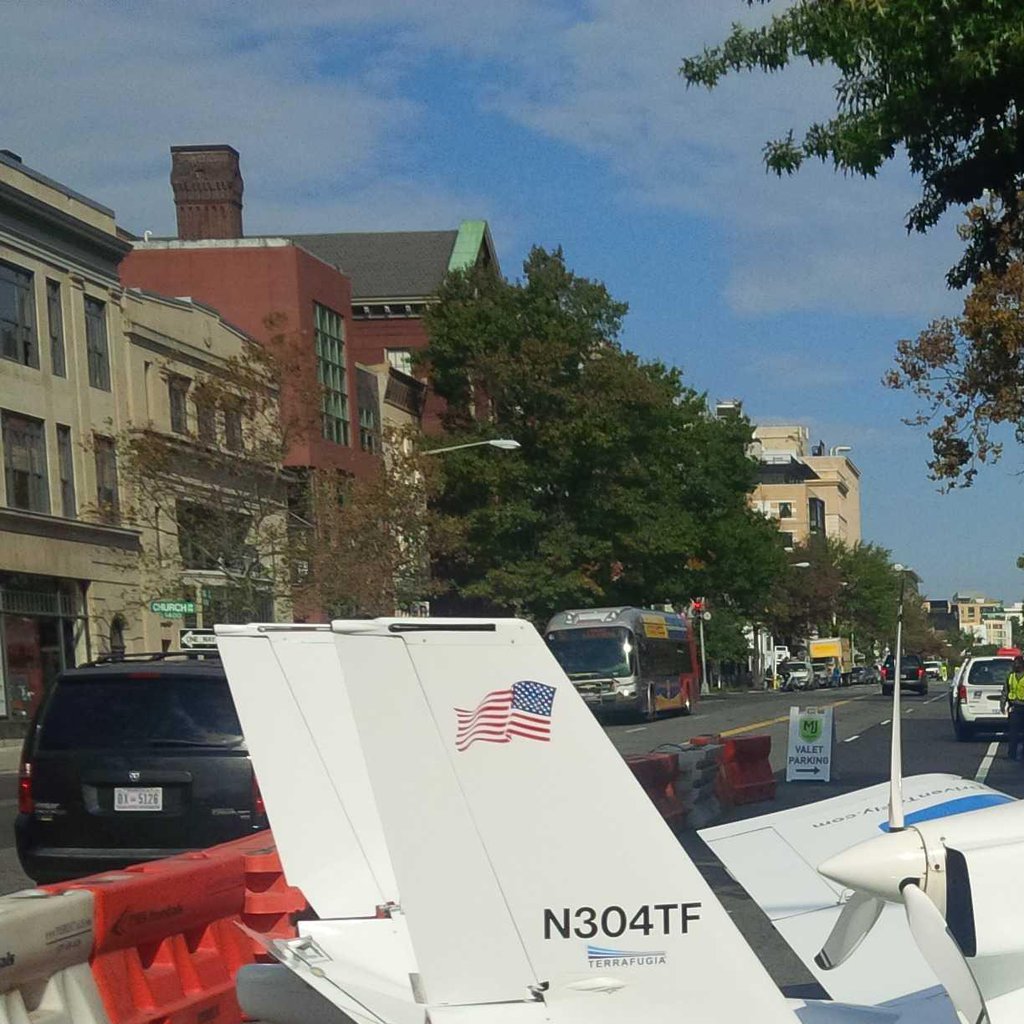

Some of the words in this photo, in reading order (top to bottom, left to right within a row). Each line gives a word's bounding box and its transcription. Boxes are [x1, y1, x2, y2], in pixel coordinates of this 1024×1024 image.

[153, 602, 187, 613] CHURCH
[795, 745, 824, 754] VALET
[788, 756, 830, 765] PARKING
[544, 902, 702, 940] N304TF
[588, 956, 667, 968] TERRAFUGIA
